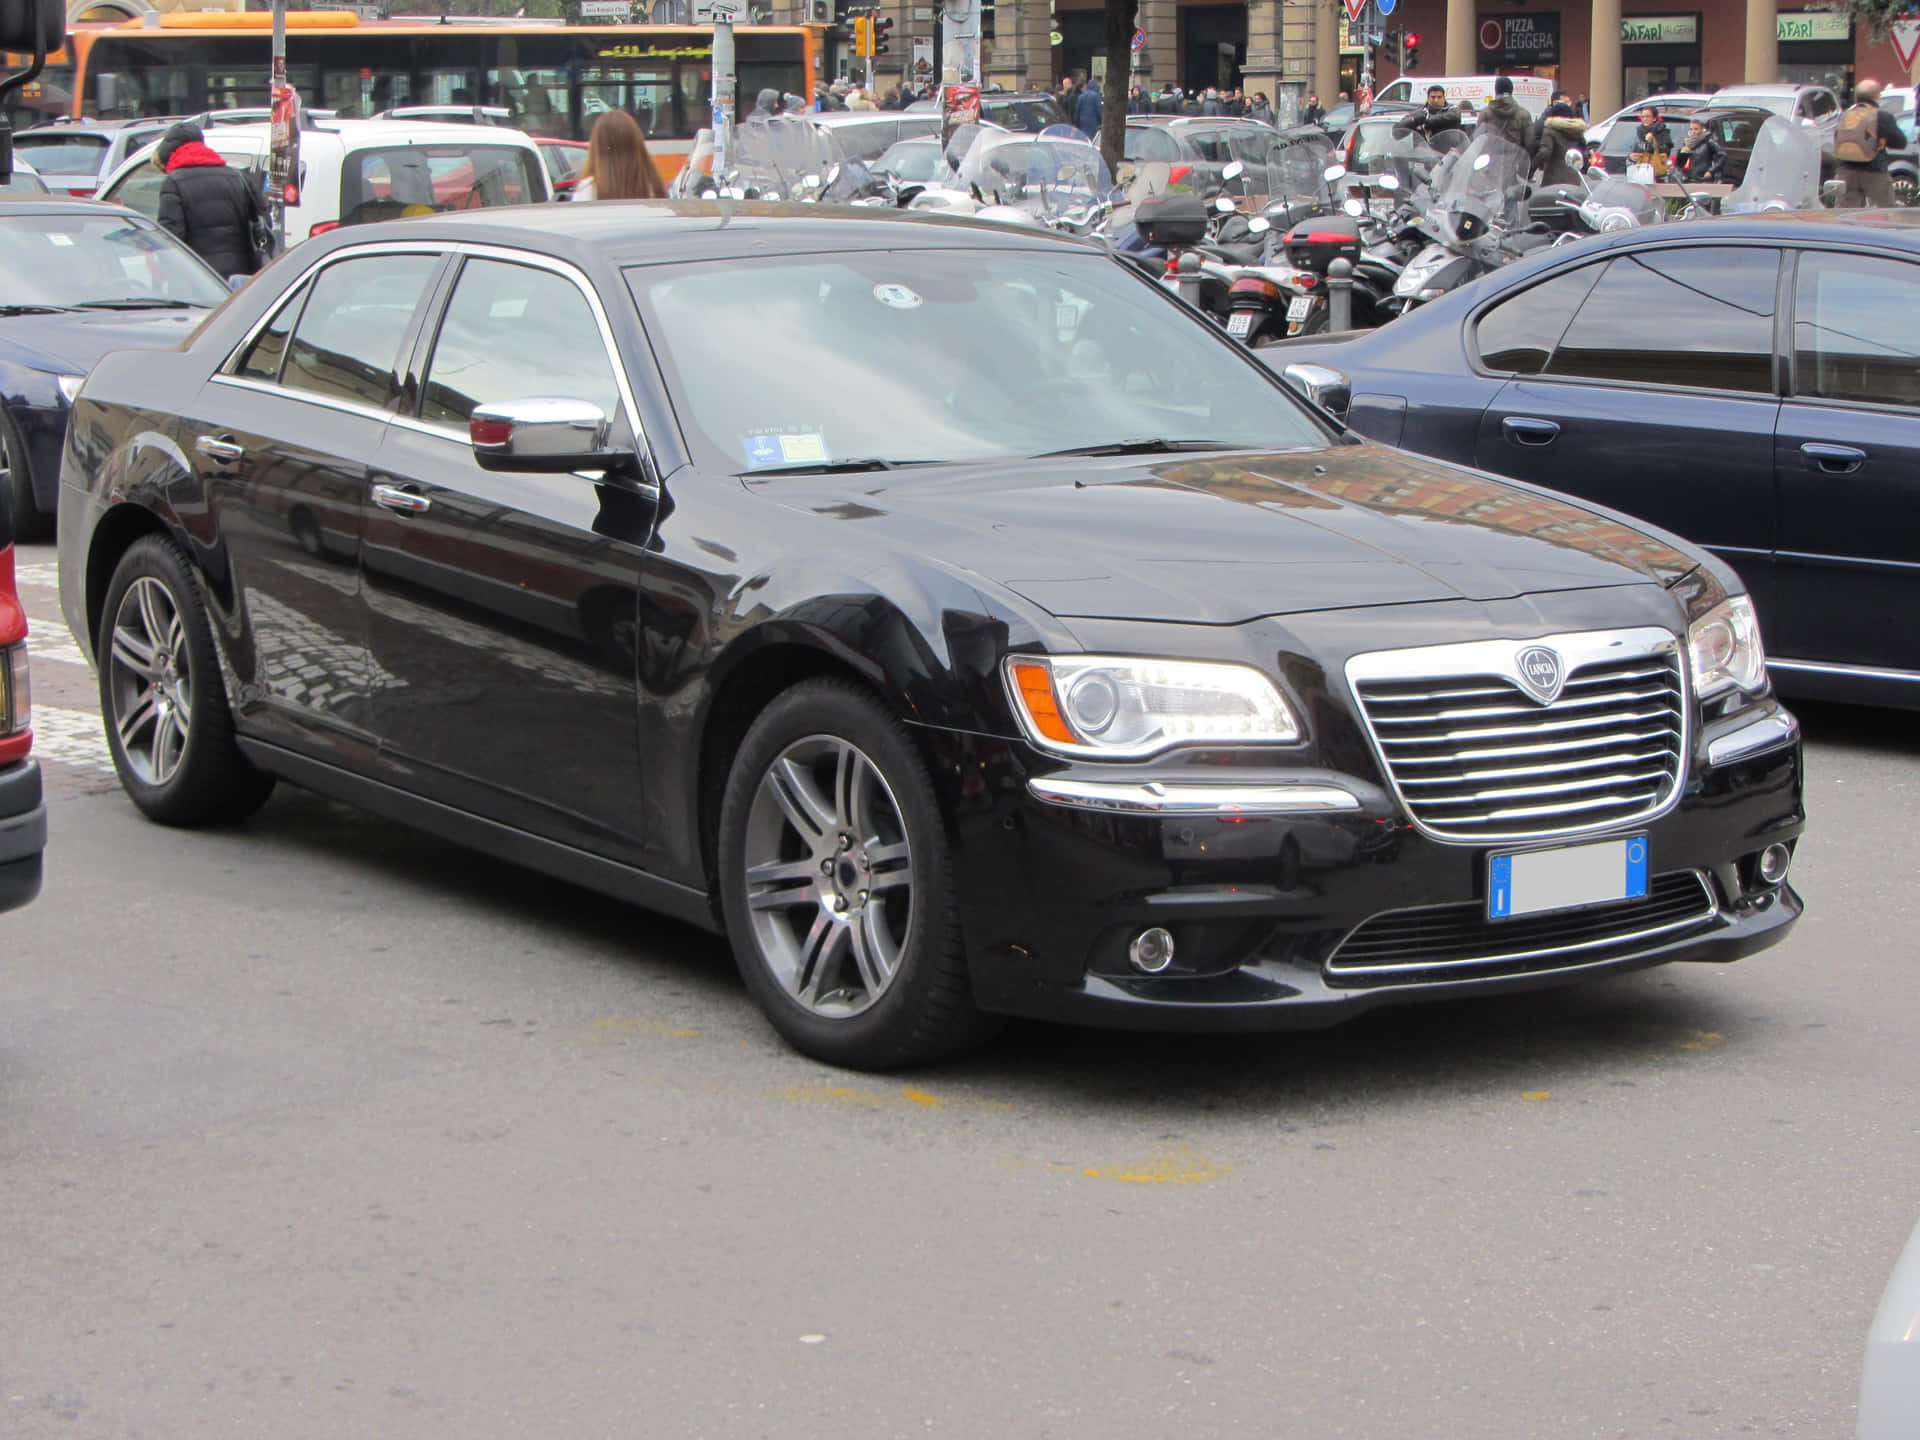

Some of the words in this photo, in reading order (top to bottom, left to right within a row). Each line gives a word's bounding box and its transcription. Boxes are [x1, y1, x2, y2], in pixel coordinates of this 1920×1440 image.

[1505, 18, 1534, 32] PIZZA
[1621, 20, 1662, 40] SAFARI
[1777, 19, 1813, 38] AFARI
[1505, 32, 1554, 49] LEGGERA
[1528, 662, 1554, 676] LANCIA
